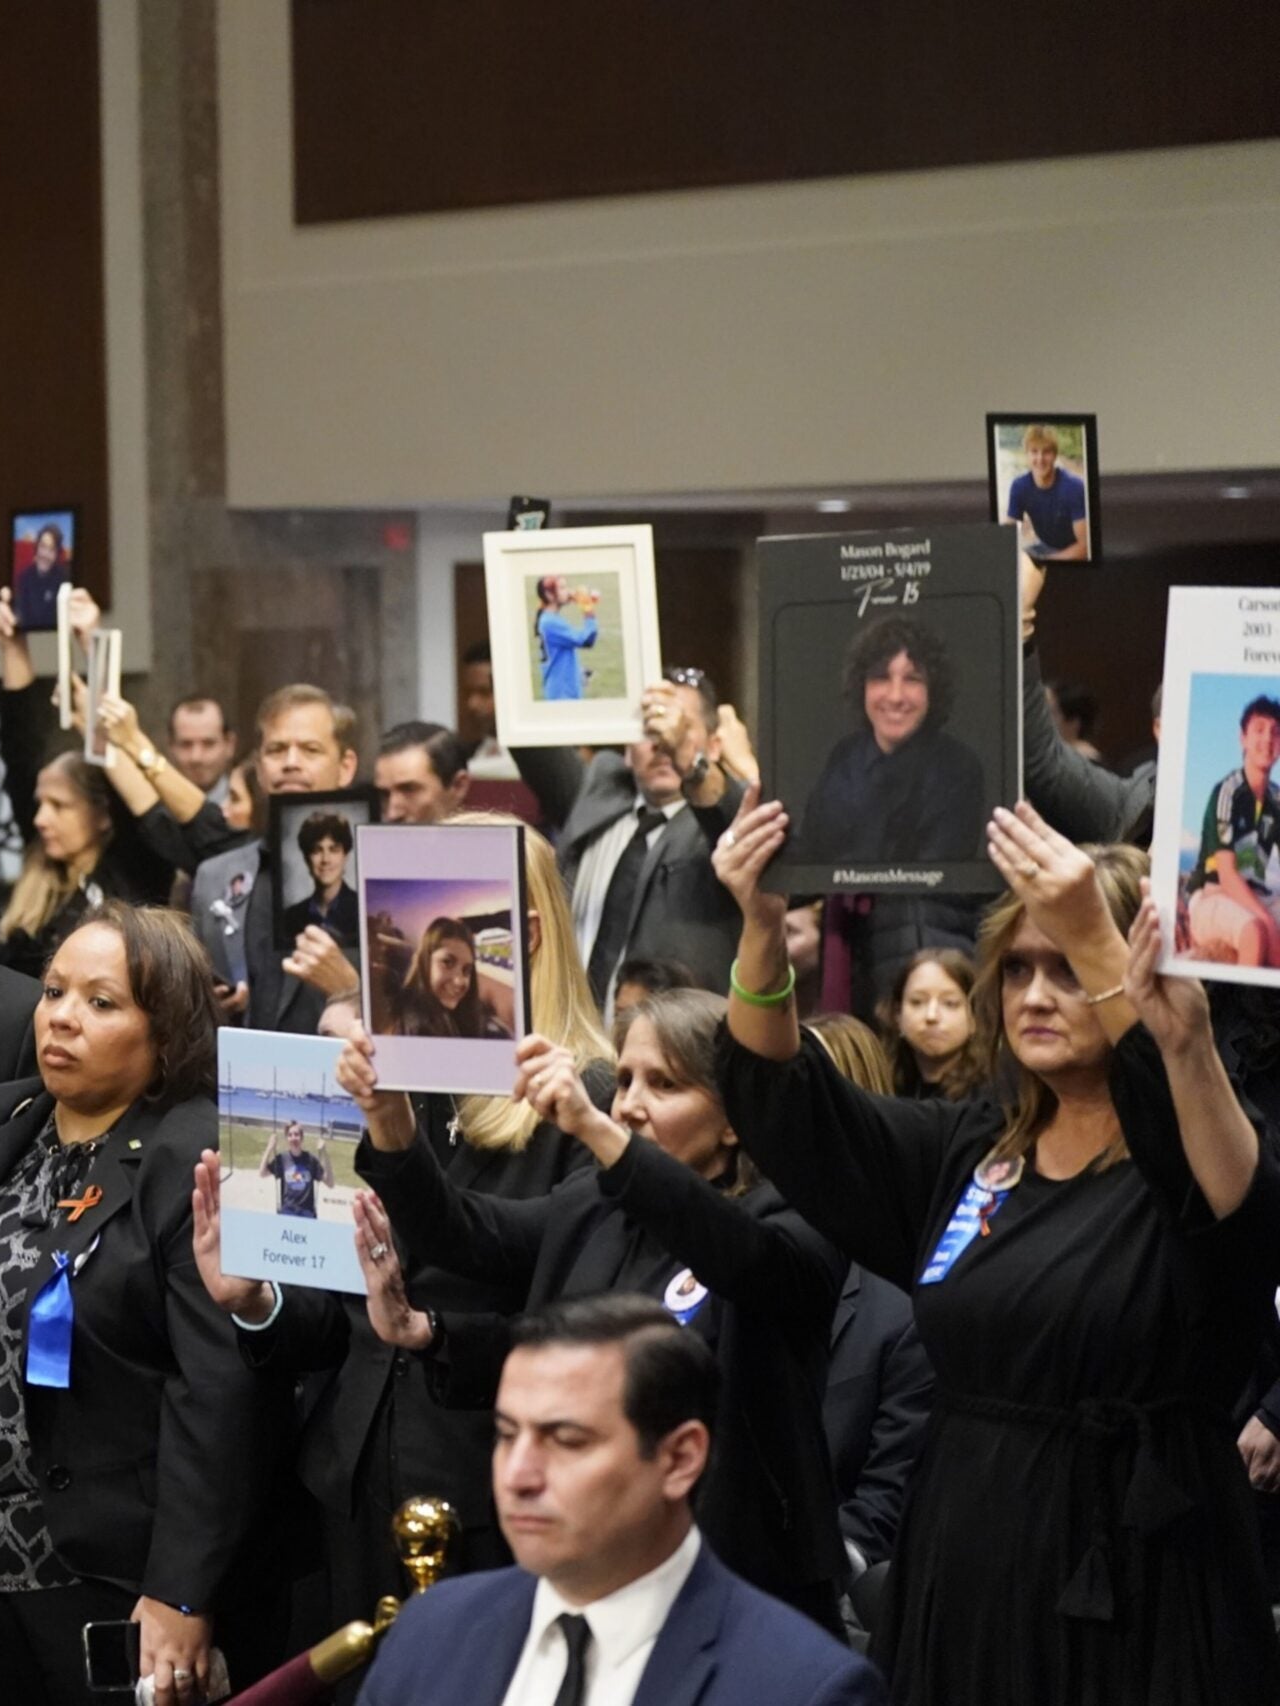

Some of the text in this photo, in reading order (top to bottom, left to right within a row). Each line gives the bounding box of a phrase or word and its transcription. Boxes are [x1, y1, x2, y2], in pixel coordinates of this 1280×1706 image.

[1238, 596, 1280, 611] Carso
[281, 1230, 307, 1244] Alex
[263, 1249, 326, 1268] Forever 17
